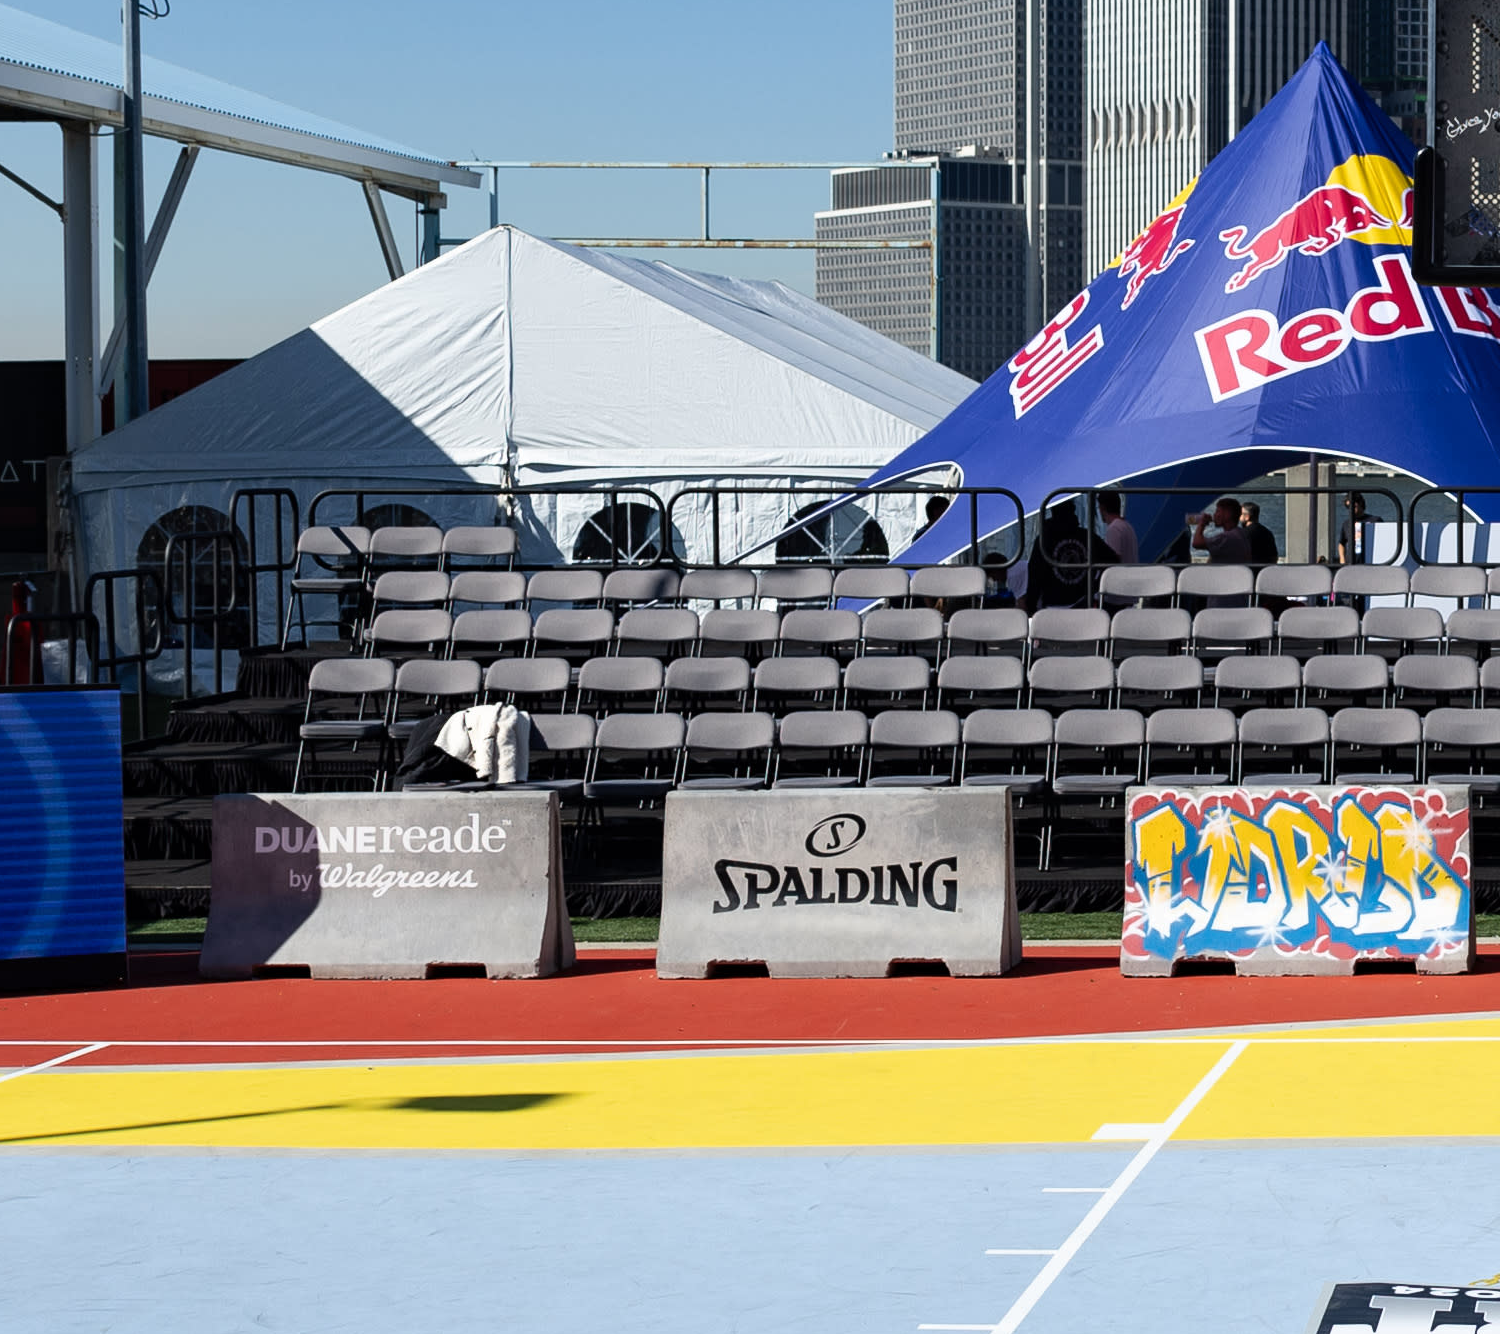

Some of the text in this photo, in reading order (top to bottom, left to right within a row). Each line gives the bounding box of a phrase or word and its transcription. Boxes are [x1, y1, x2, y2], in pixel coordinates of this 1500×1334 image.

[1194, 253, 1434, 403] Red
[289, 863, 478, 898] by Walgreens
[712, 856, 959, 914] SPALDING
